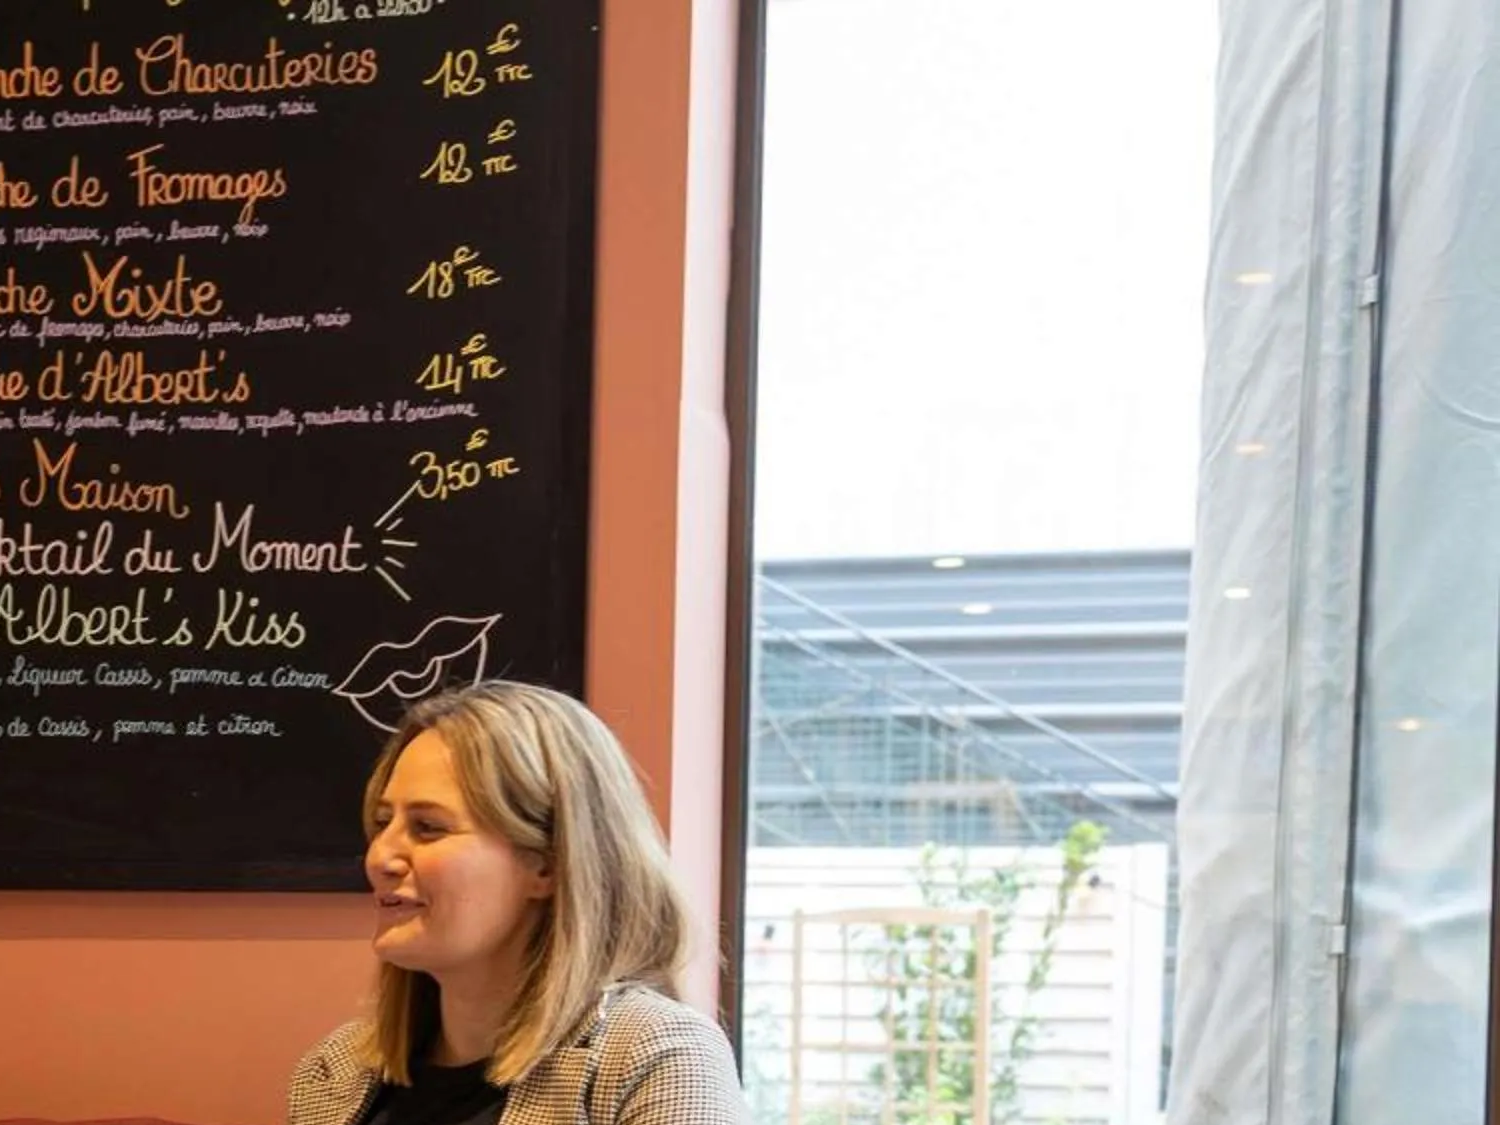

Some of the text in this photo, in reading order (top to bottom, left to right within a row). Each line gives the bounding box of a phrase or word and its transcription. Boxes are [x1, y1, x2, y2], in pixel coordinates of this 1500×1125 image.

[73, 41, 123, 96] de
[136, 33, 377, 95] Charcuteries
[494, 63, 533, 82] TTC
[22, 111, 47, 130] de
[51, 155, 109, 207] de
[126, 143, 288, 227] Fromages
[481, 154, 518, 176] TTC
[71, 250, 223, 322] Mixte
[9, 319, 33, 337] de
[38, 350, 251, 404] d'Albert's
[19, 437, 191, 518] Maison
[124, 530, 183, 575] du
[193, 501, 369, 574] Moment
[205, 588, 306, 652] Kiss
[169, 667, 244, 694] pomme
[7, 716, 31, 737] de
[113, 719, 175, 743] pomme
[185, 714, 209, 737] et
